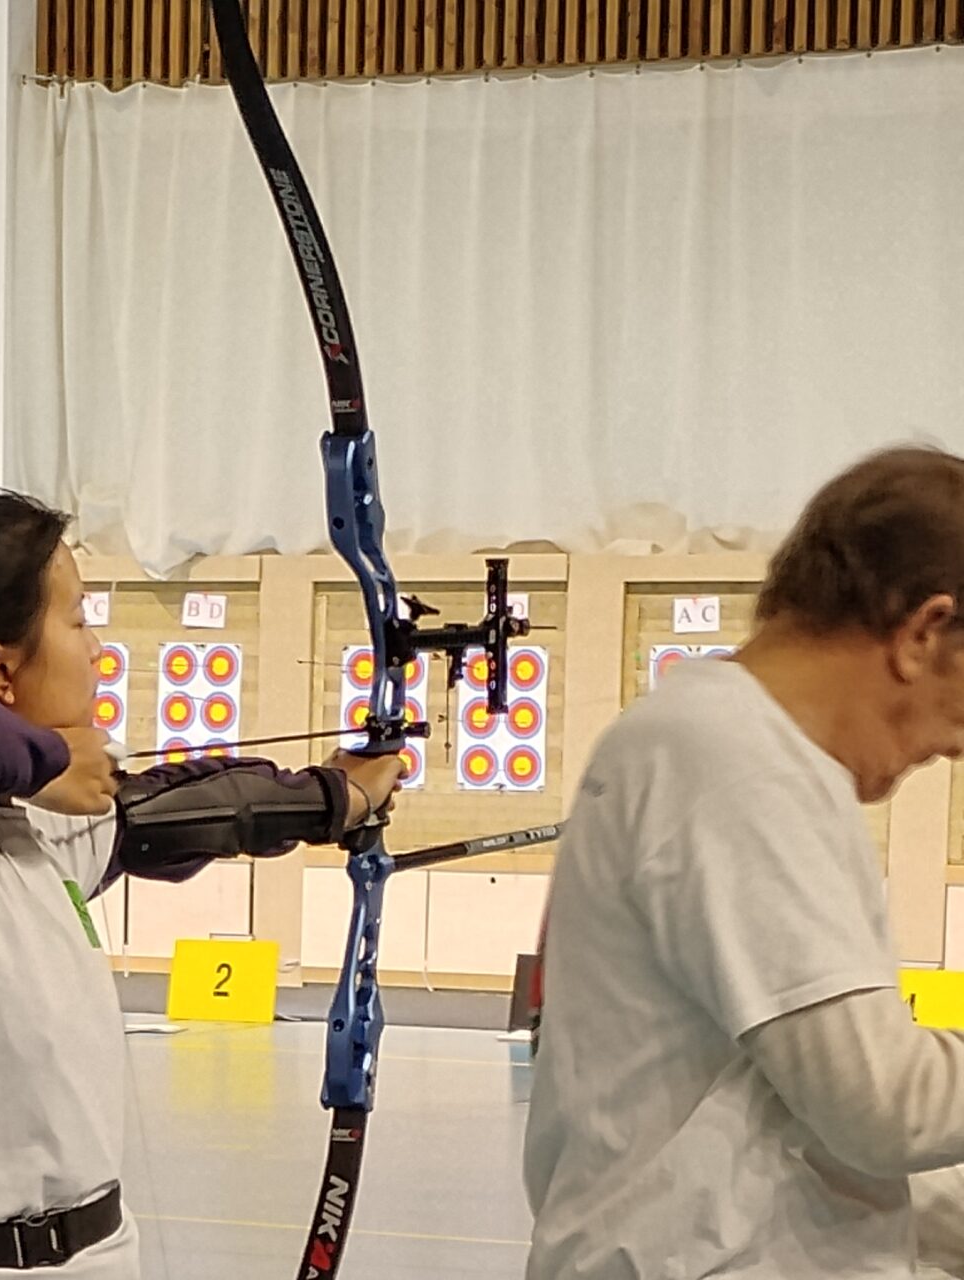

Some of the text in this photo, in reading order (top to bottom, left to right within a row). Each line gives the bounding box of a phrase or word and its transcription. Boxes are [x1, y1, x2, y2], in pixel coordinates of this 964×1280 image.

[269, 167, 340, 345] CORNERSTONE
[187, 601, 223, 619] B D
[677, 605, 716, 624] A C
[213, 963, 233, 997] 2
[318, 1174, 350, 1242] NIK
